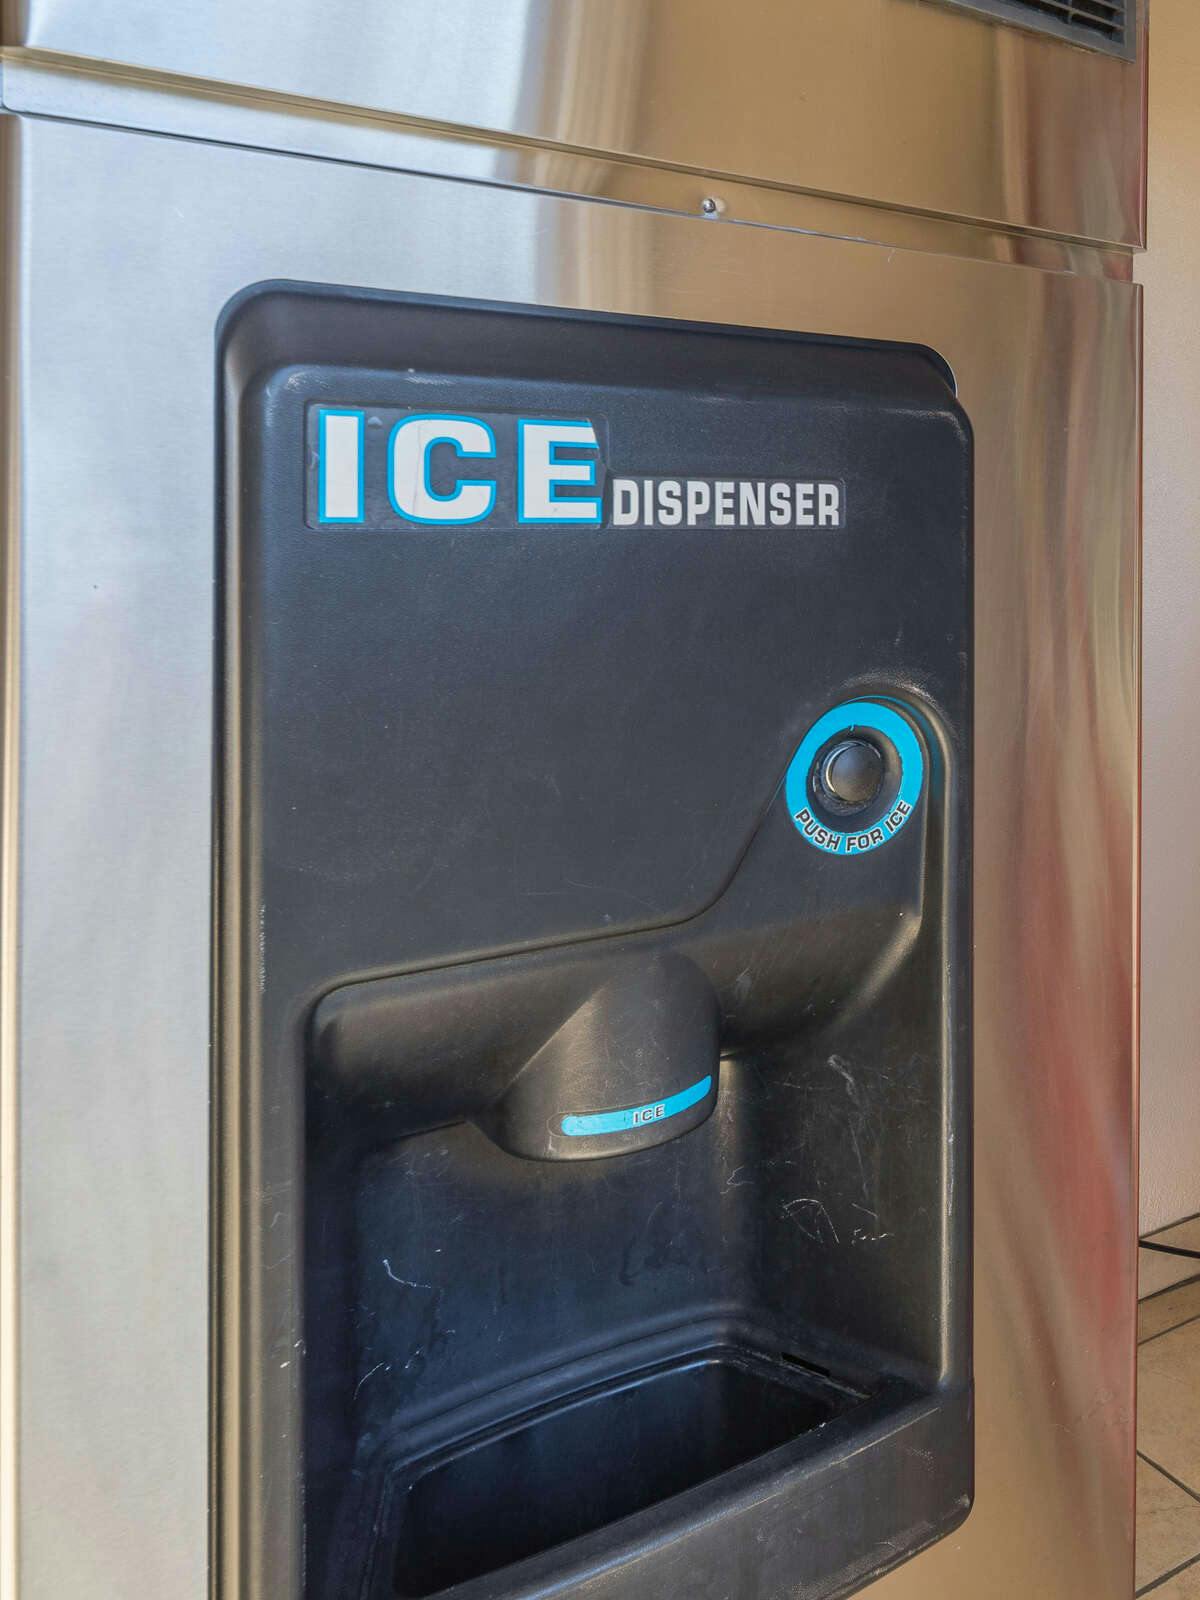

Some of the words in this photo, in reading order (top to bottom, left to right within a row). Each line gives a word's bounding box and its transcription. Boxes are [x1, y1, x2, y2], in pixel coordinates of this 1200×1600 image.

[318, 409, 601, 526] ICE
[611, 478, 842, 528] DISPENSER
[793, 806, 842, 852] PUSH
[845, 826, 885, 852] FOR
[883, 799, 913, 833] ICE
[632, 1104, 666, 1125] ICE
